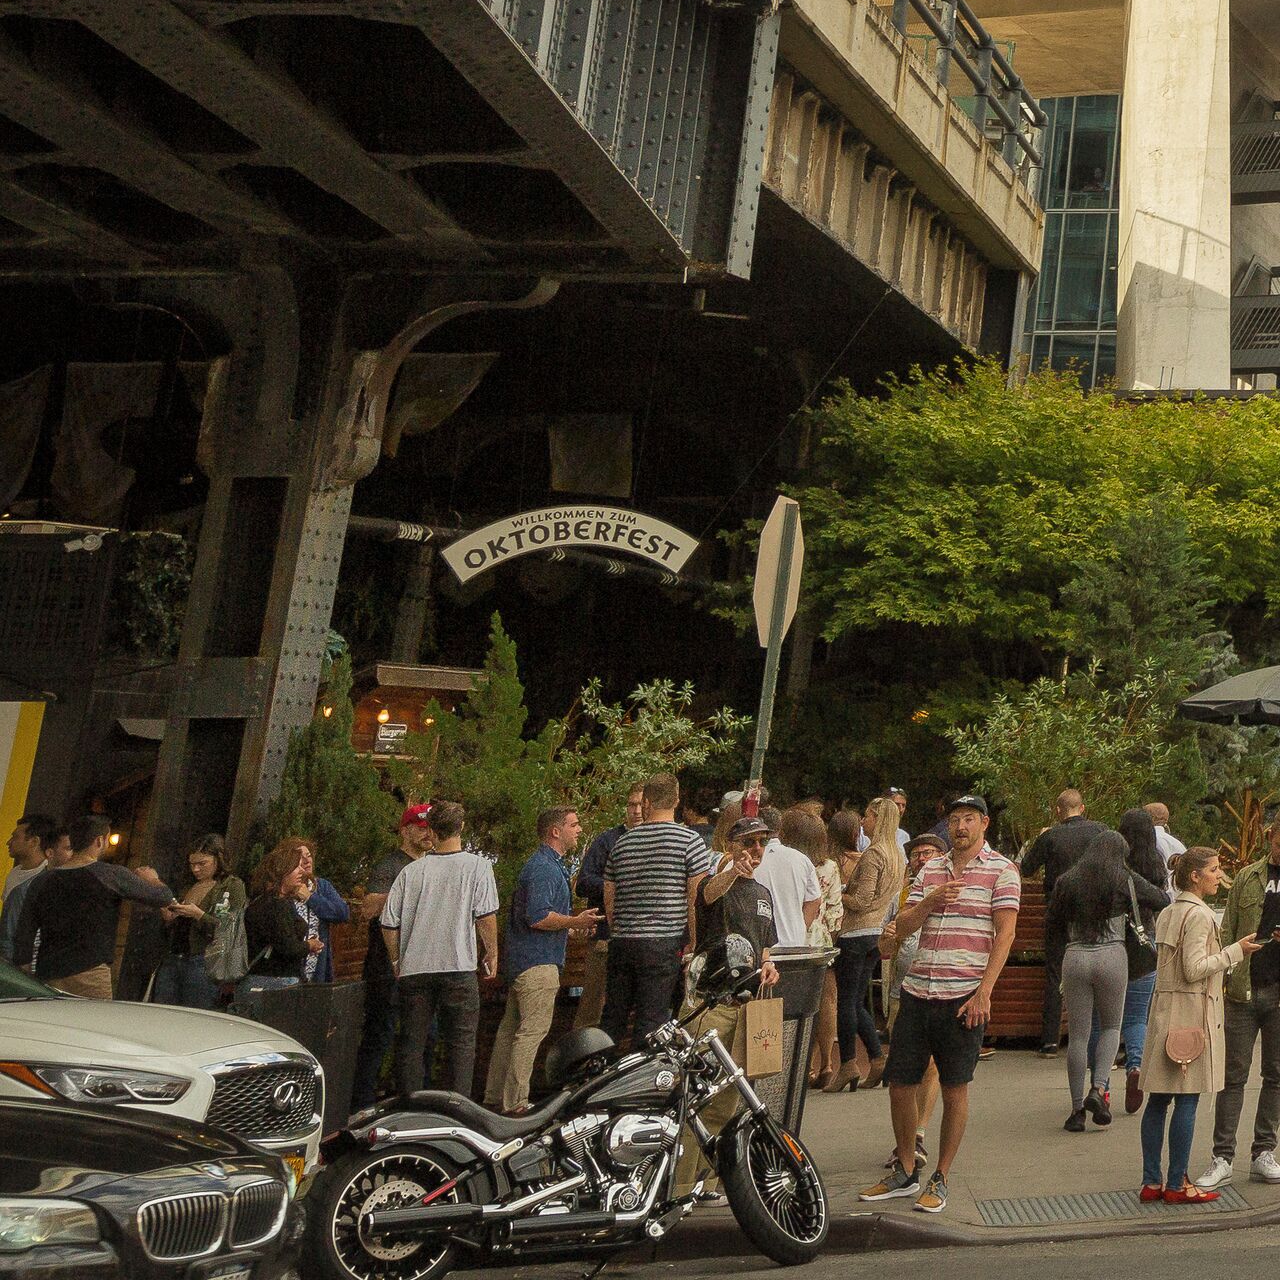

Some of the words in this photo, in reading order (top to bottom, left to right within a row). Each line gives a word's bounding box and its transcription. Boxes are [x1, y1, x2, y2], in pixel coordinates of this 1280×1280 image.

[511, 509, 605, 529] WILLKOMMEN
[609, 511, 637, 525] ZUM
[463, 519, 681, 569] OKTOBERFEST
